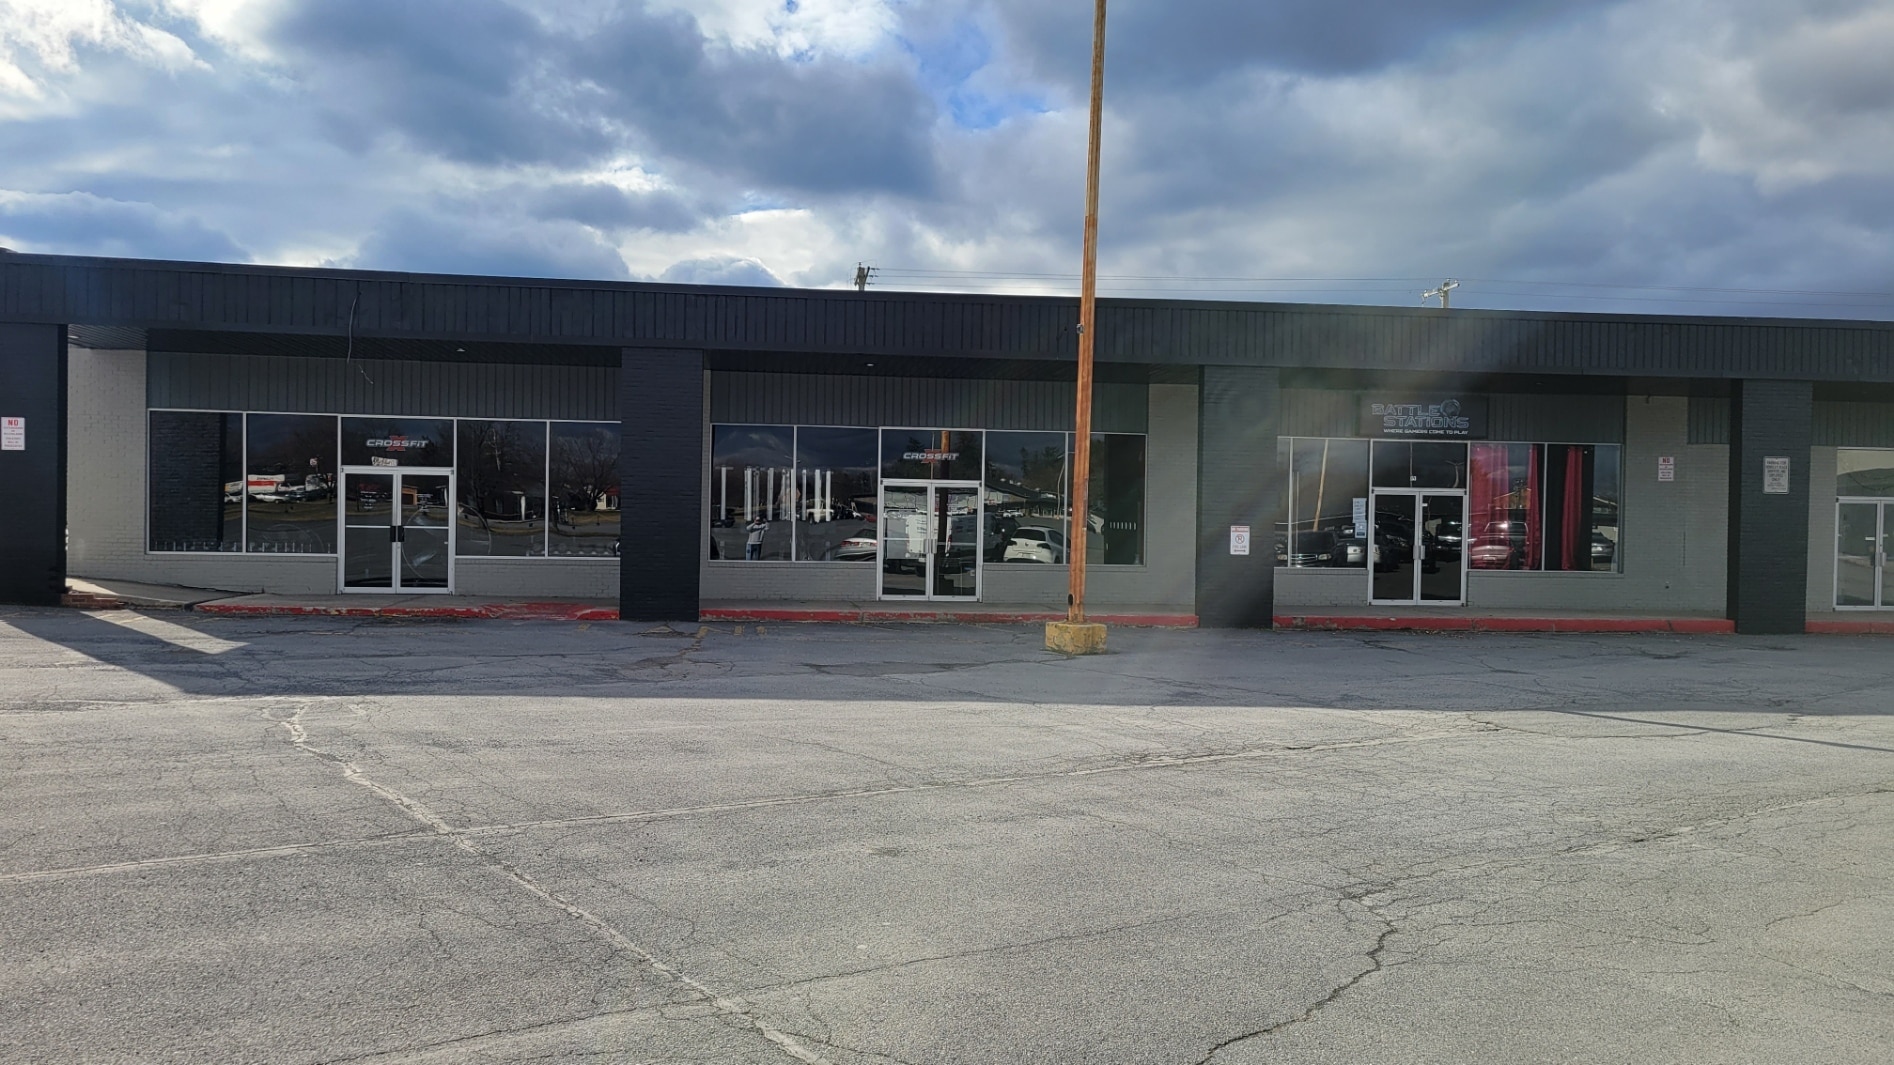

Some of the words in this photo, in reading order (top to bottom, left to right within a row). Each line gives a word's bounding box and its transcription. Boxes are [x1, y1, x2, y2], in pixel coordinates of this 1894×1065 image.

[1371, 403, 1441, 416] BATTLE
[1383, 416, 1469, 429] STATIONS
[366, 439, 428, 448] CROSSFIT
[903, 452, 959, 460] CROSSFIT
